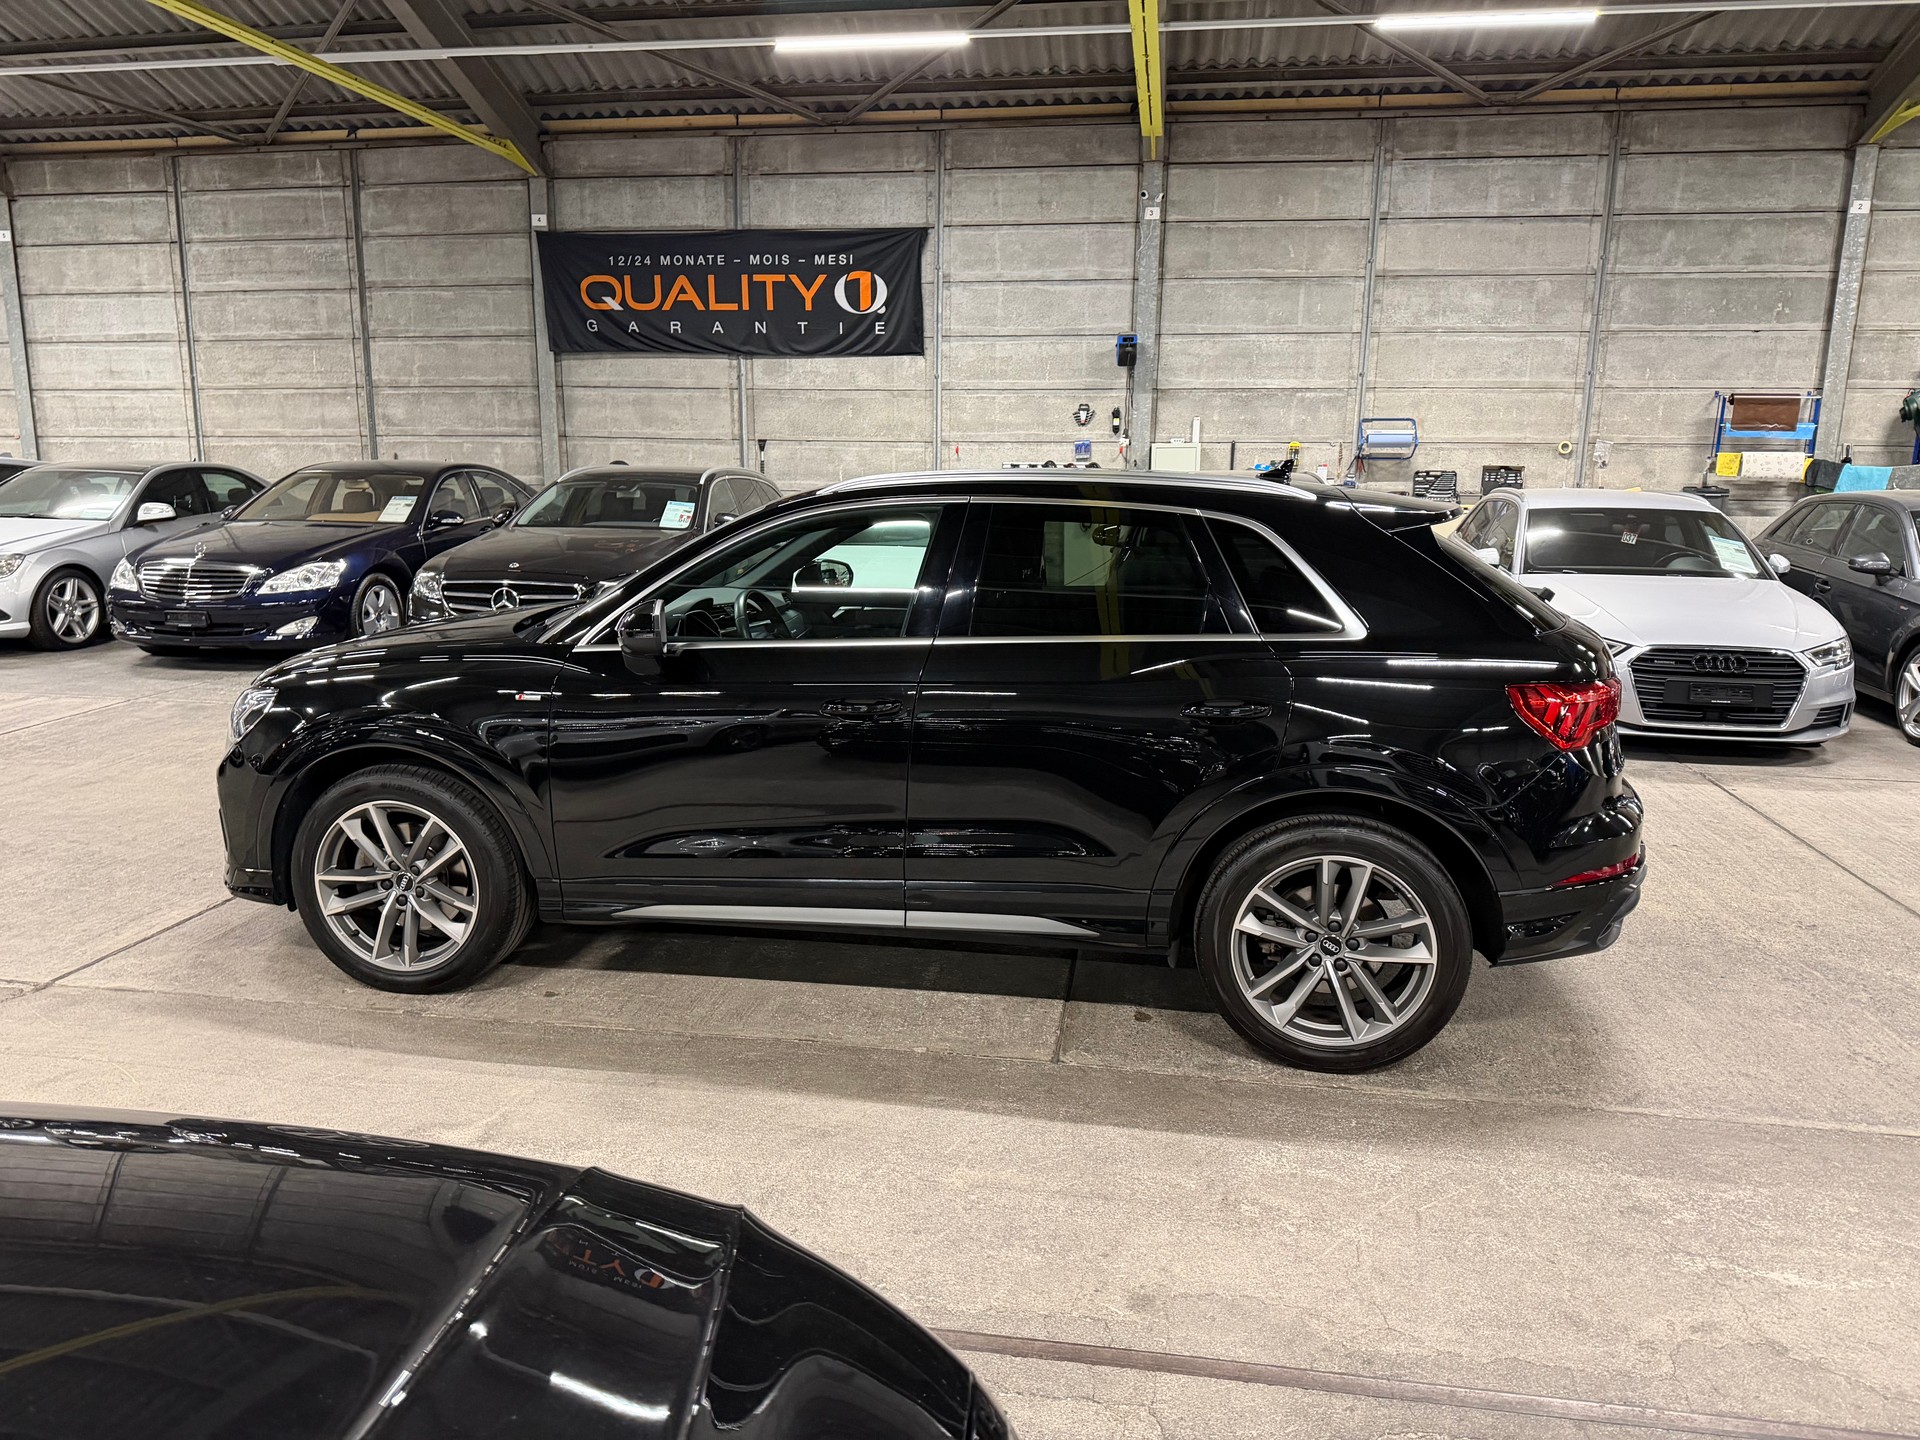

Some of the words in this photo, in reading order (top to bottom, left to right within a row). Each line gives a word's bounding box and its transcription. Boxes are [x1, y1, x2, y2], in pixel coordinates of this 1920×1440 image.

[608, 255, 652, 266] 12/24
[660, 254, 726, 266] MONATE
[749, 254, 790, 266] MOIS
[814, 254, 854, 266] MESI
[580, 274, 828, 311] QUALITY
[586, 319, 886, 335] GARANTIE
